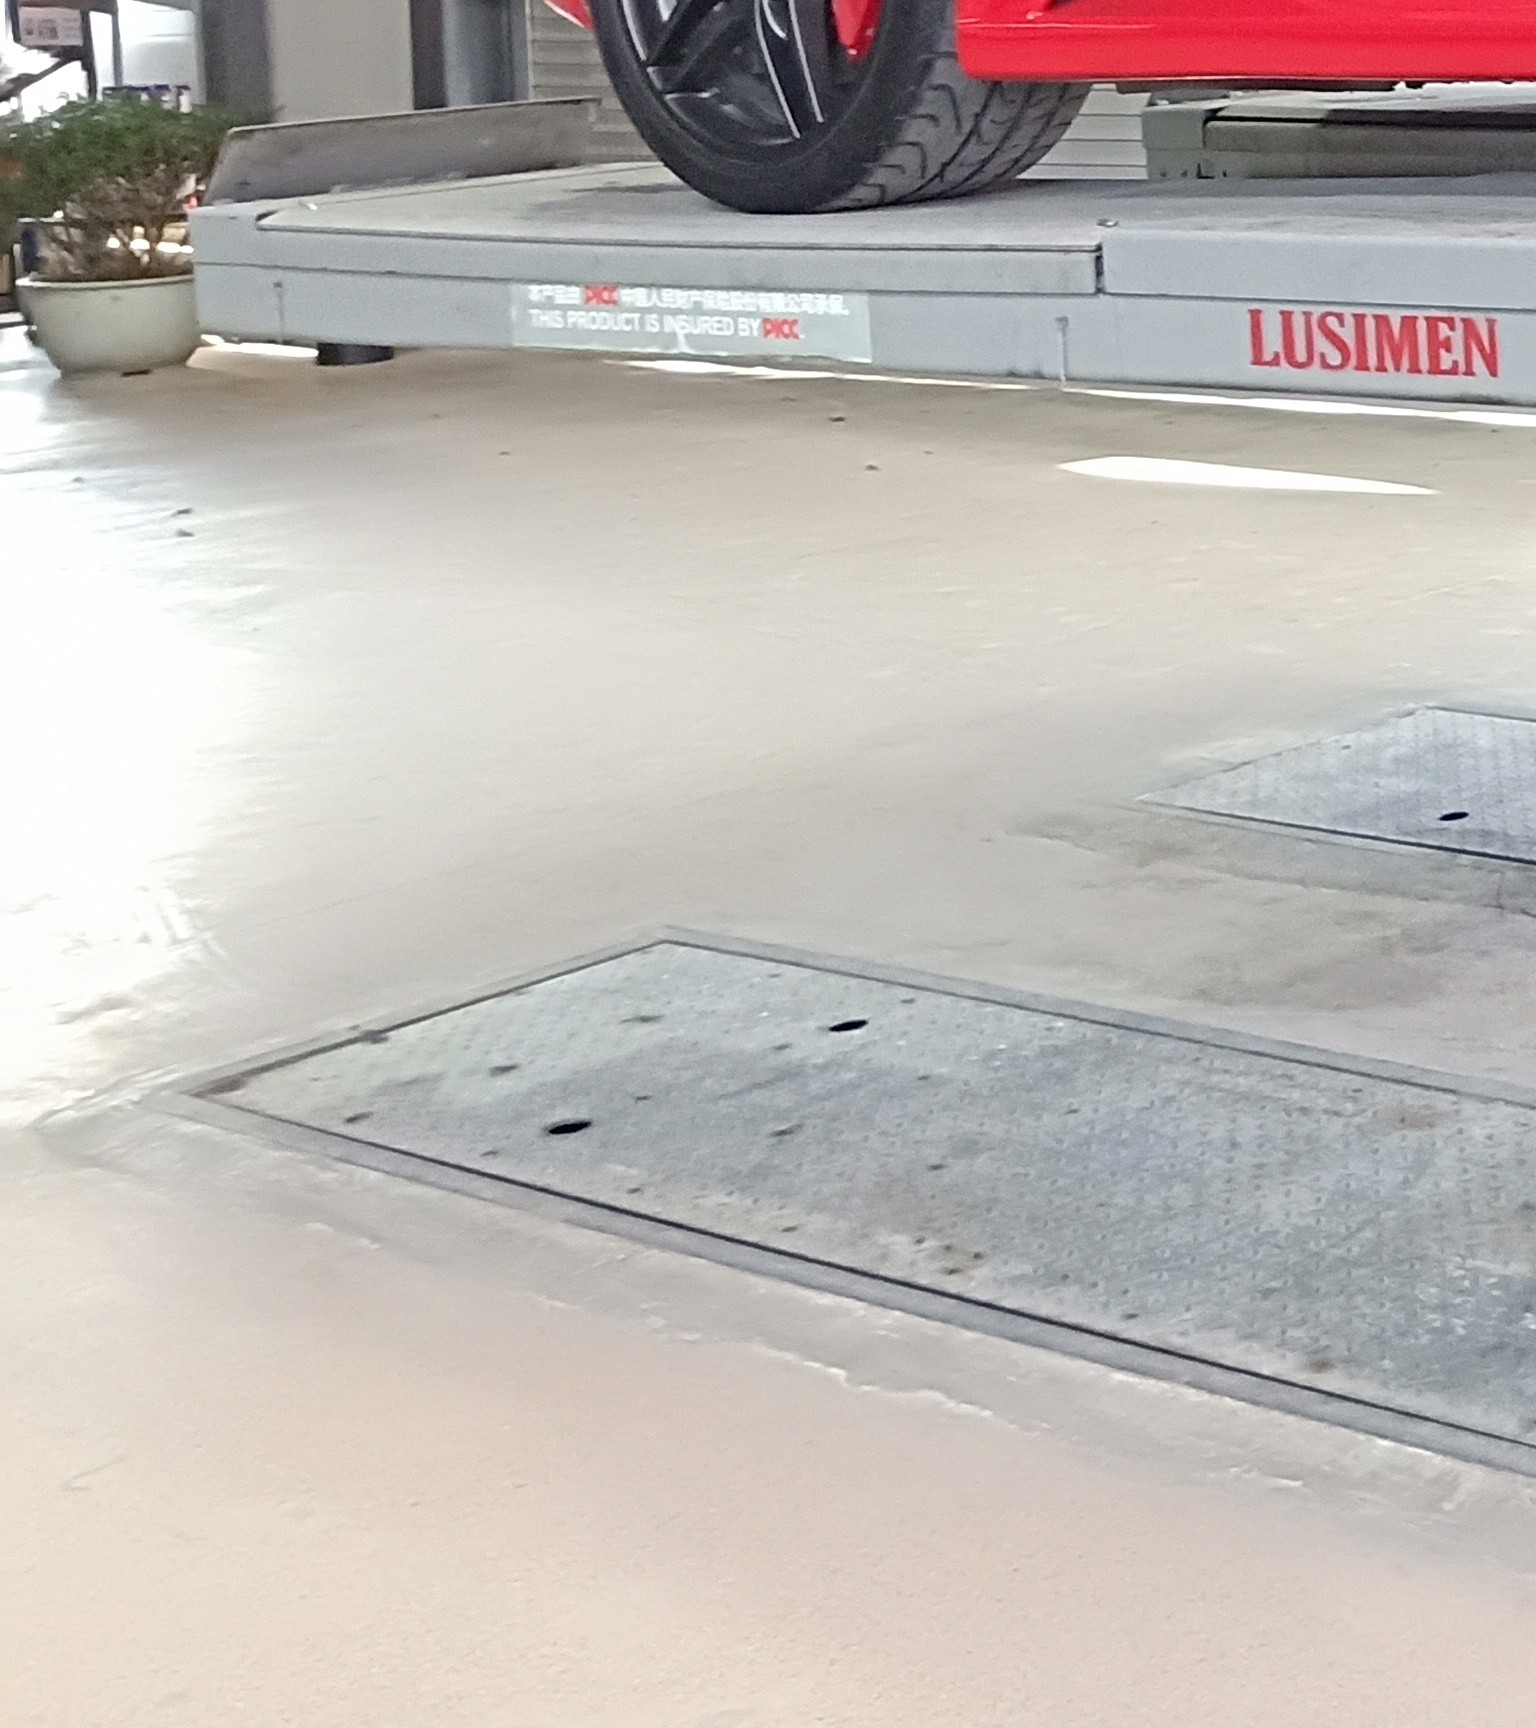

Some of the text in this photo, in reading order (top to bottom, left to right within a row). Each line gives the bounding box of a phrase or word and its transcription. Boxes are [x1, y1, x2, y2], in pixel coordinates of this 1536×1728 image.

[567, 310, 641, 332] PRODUCT
[738, 316, 762, 337] BY
[1248, 308, 1499, 379] LUSIMEN
